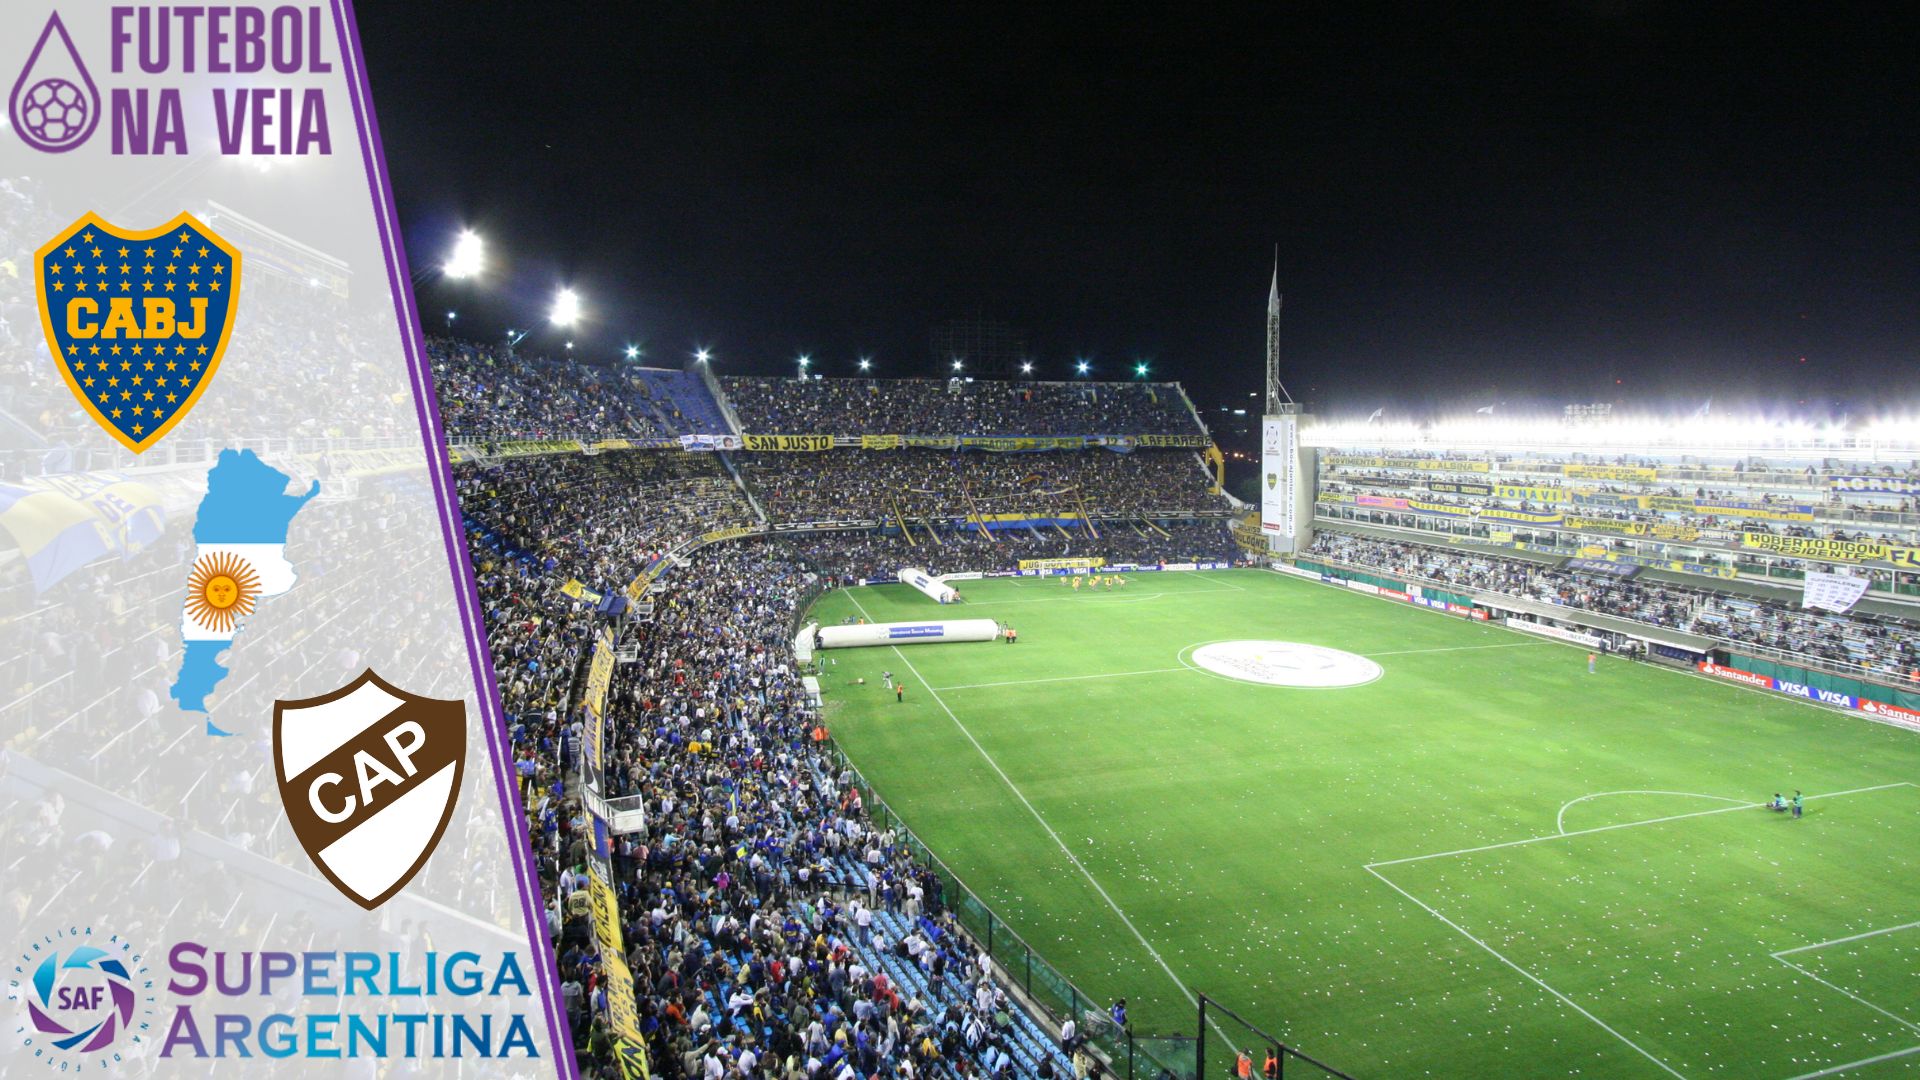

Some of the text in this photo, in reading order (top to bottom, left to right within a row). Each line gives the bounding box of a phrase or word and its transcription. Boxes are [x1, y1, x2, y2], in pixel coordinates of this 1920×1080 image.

[748, 436, 829, 450] SAN JUSTO
[1329, 458, 1376, 466] MOVIMIENTO
[1382, 459, 1419, 468] XENEIZE
[1499, 488, 1558, 500] FONAVI
[1750, 533, 1881, 554] ROBERTO DIGON
[1759, 543, 1867, 559] PRESIDENTE
[1413, 595, 1428, 606] VISA
[1431, 599, 1446, 610] VISA
[1714, 665, 1767, 687] Santander
[1778, 680, 1810, 698] VISA
[1817, 689, 1851, 707] VISA
